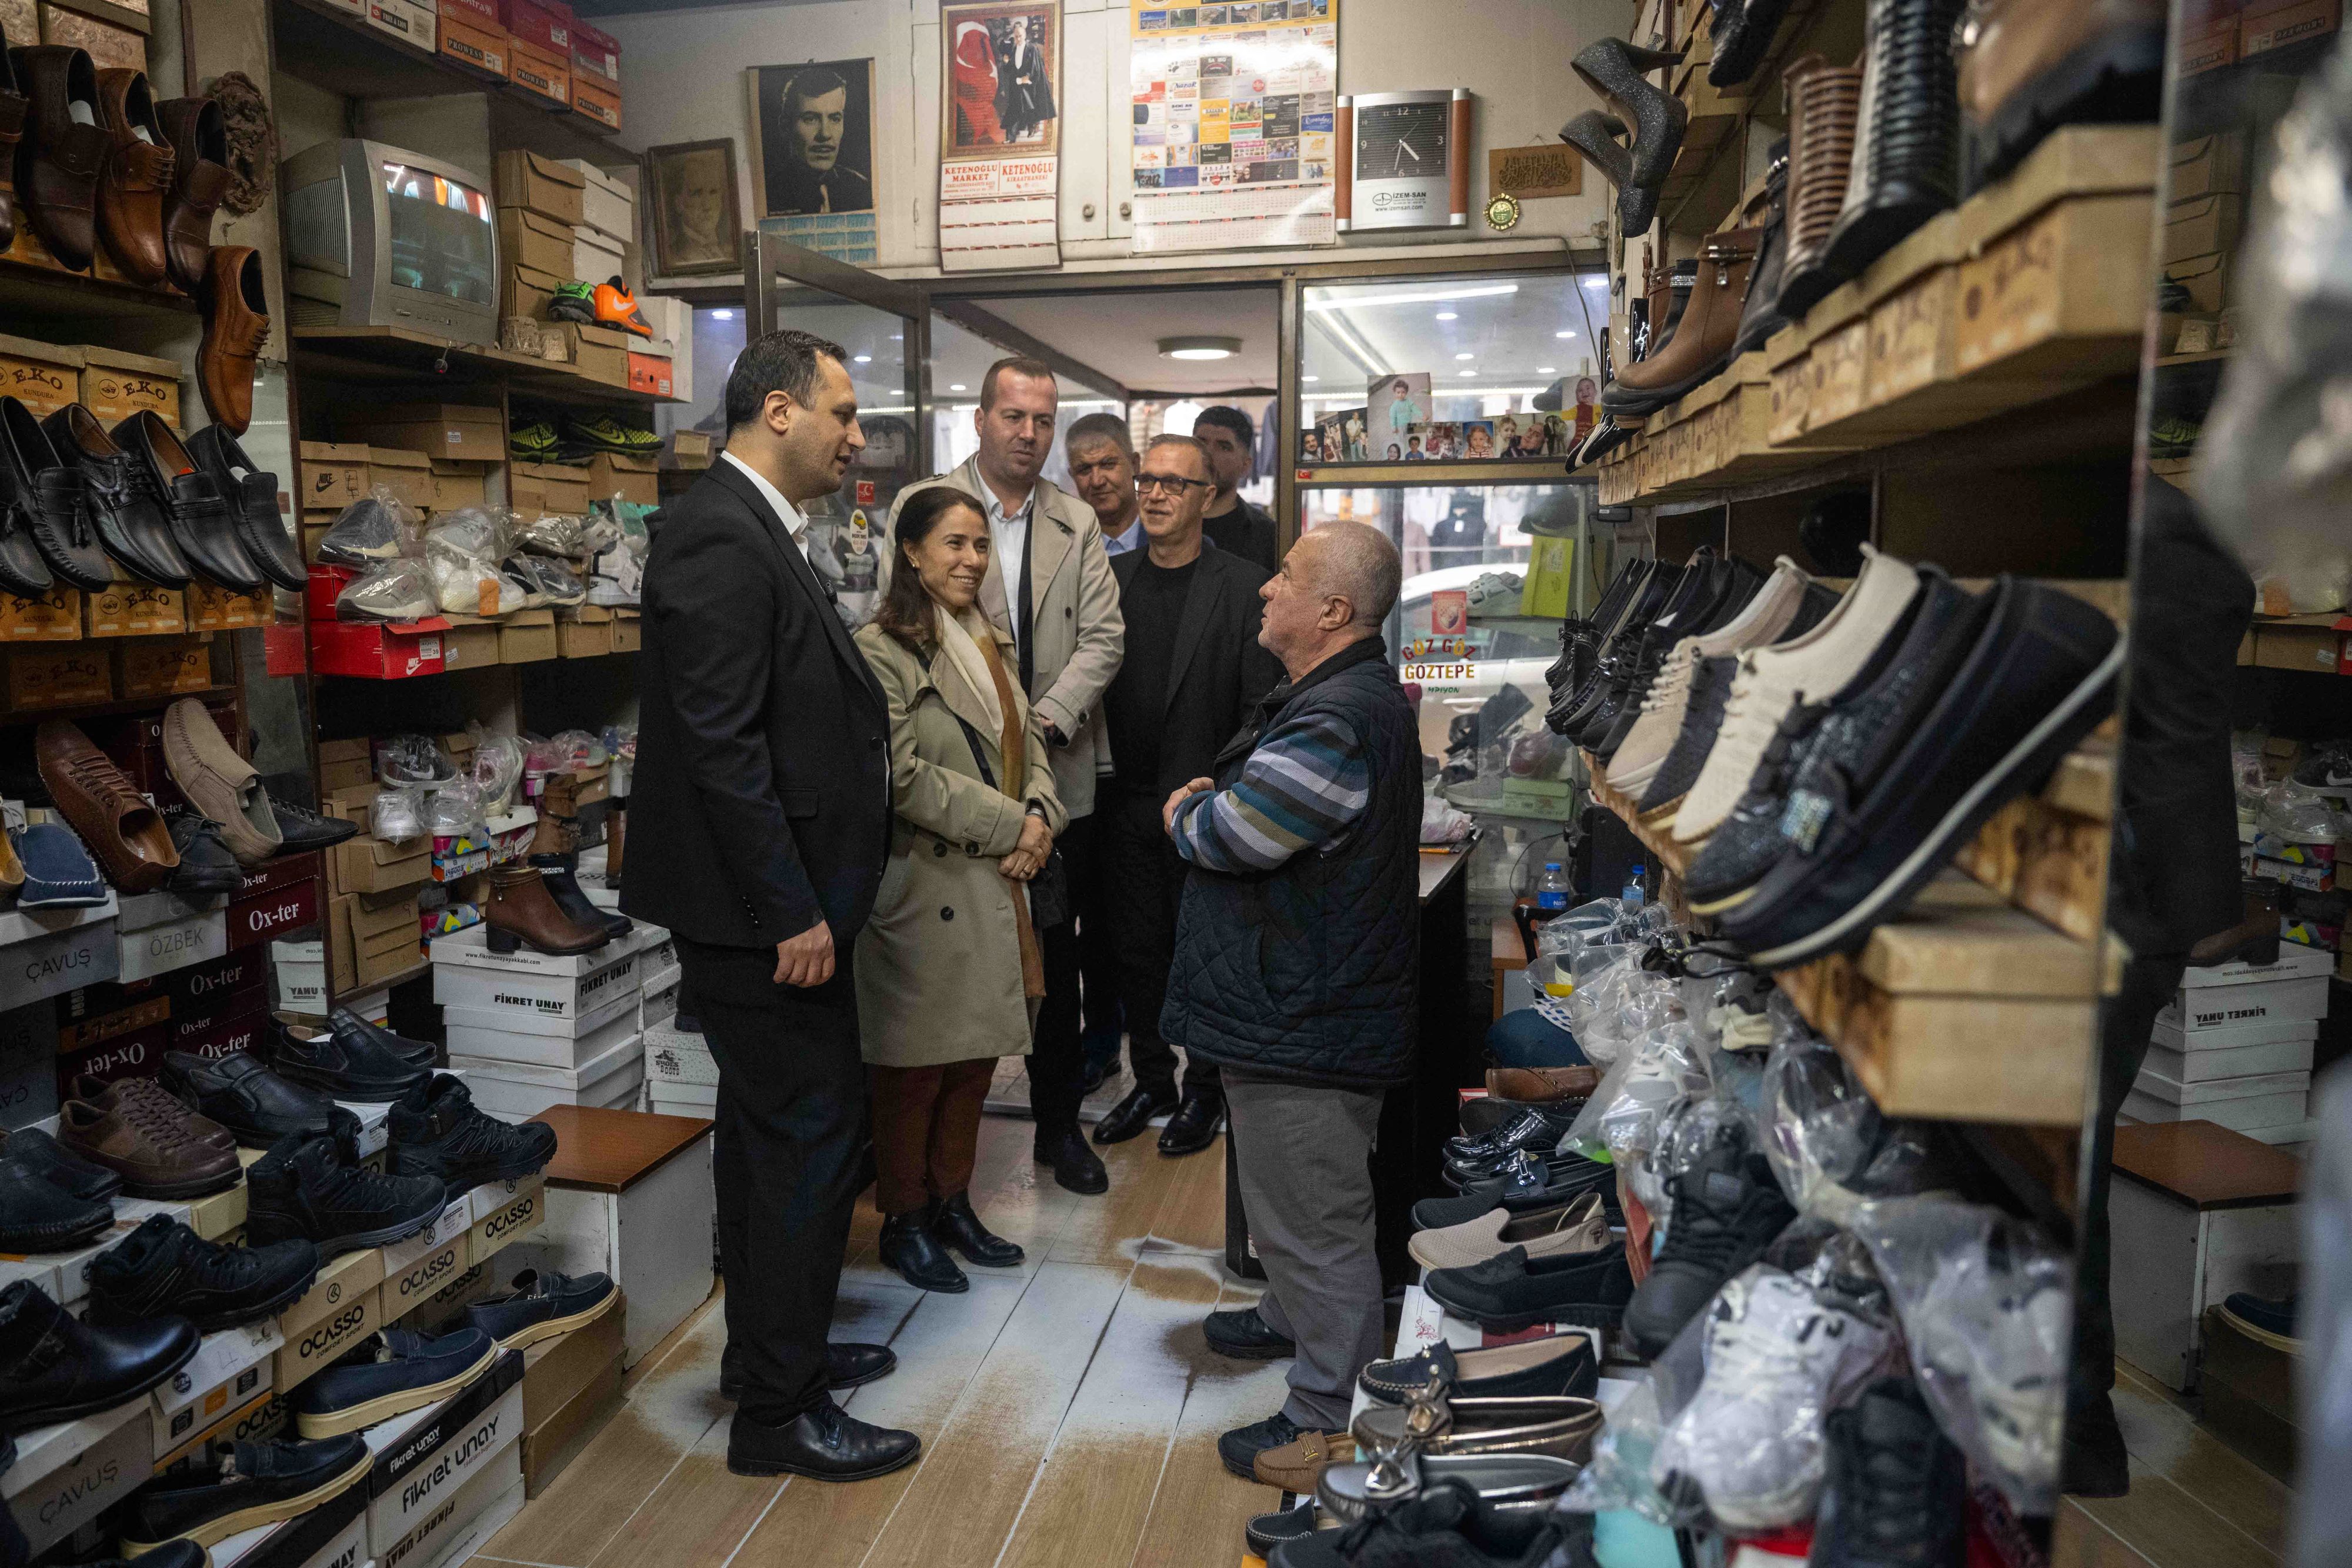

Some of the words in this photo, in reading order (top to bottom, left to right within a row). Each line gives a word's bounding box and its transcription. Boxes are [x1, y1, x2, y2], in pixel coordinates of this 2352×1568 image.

[448, 38, 483, 59] PROWESS
[518, 69, 548, 89] PROWESS
[1397, 107, 1409, 116] 12
[1360, 141, 1367, 149] 9
[1437, 136, 1443, 145] 3
[945, 164, 997, 175] KETENOĞLU
[953, 174, 989, 182] MARKET
[1002, 161, 1054, 175] KETENOĞLU
[12, 368, 63, 390] EKO
[24, 389, 54, 399] KUNDURA
[122, 381, 166, 400] EKO
[132, 401, 159, 409] KUNDURA
[125, 588, 169, 609] EKO
[223, 590, 262, 605] EO
[249, 902, 299, 931] Ox-ter
[151, 928, 203, 957] ÖZBEK
[26, 949, 91, 983] ÇAVUŞ
[465, 953, 541, 965] www.fikretunayayakkabi.com
[190, 966, 242, 995] Ox-ter
[581, 972, 608, 996] FİKRET
[610, 961, 632, 981] UNAY
[495, 993, 533, 1006] FİKRET
[536, 999, 565, 1010] UNAY
[181, 1017, 211, 1035] Ox-ter
[199, 1033, 251, 1059] Ox-ter
[85, 1043, 145, 1075] Ox-ter
[660, 1065, 680, 1075] BOOTS
[486, 1199, 533, 1238] OCASSO
[498, 1225, 519, 1240] COMFORT
[519, 1214, 535, 1230] SPORT
[400, 1250, 455, 1295] OCASSO
[413, 1277, 438, 1297] COMFORT
[438, 1267, 455, 1282] SPORT
[300, 1305, 364, 1357] OCASSO
[316, 1336, 345, 1359] COMFORT
[345, 1323, 365, 1342] SPORT
[40, 1459, 118, 1525] ÇAVUŞ
[416, 1500, 455, 1543] FİKRET
